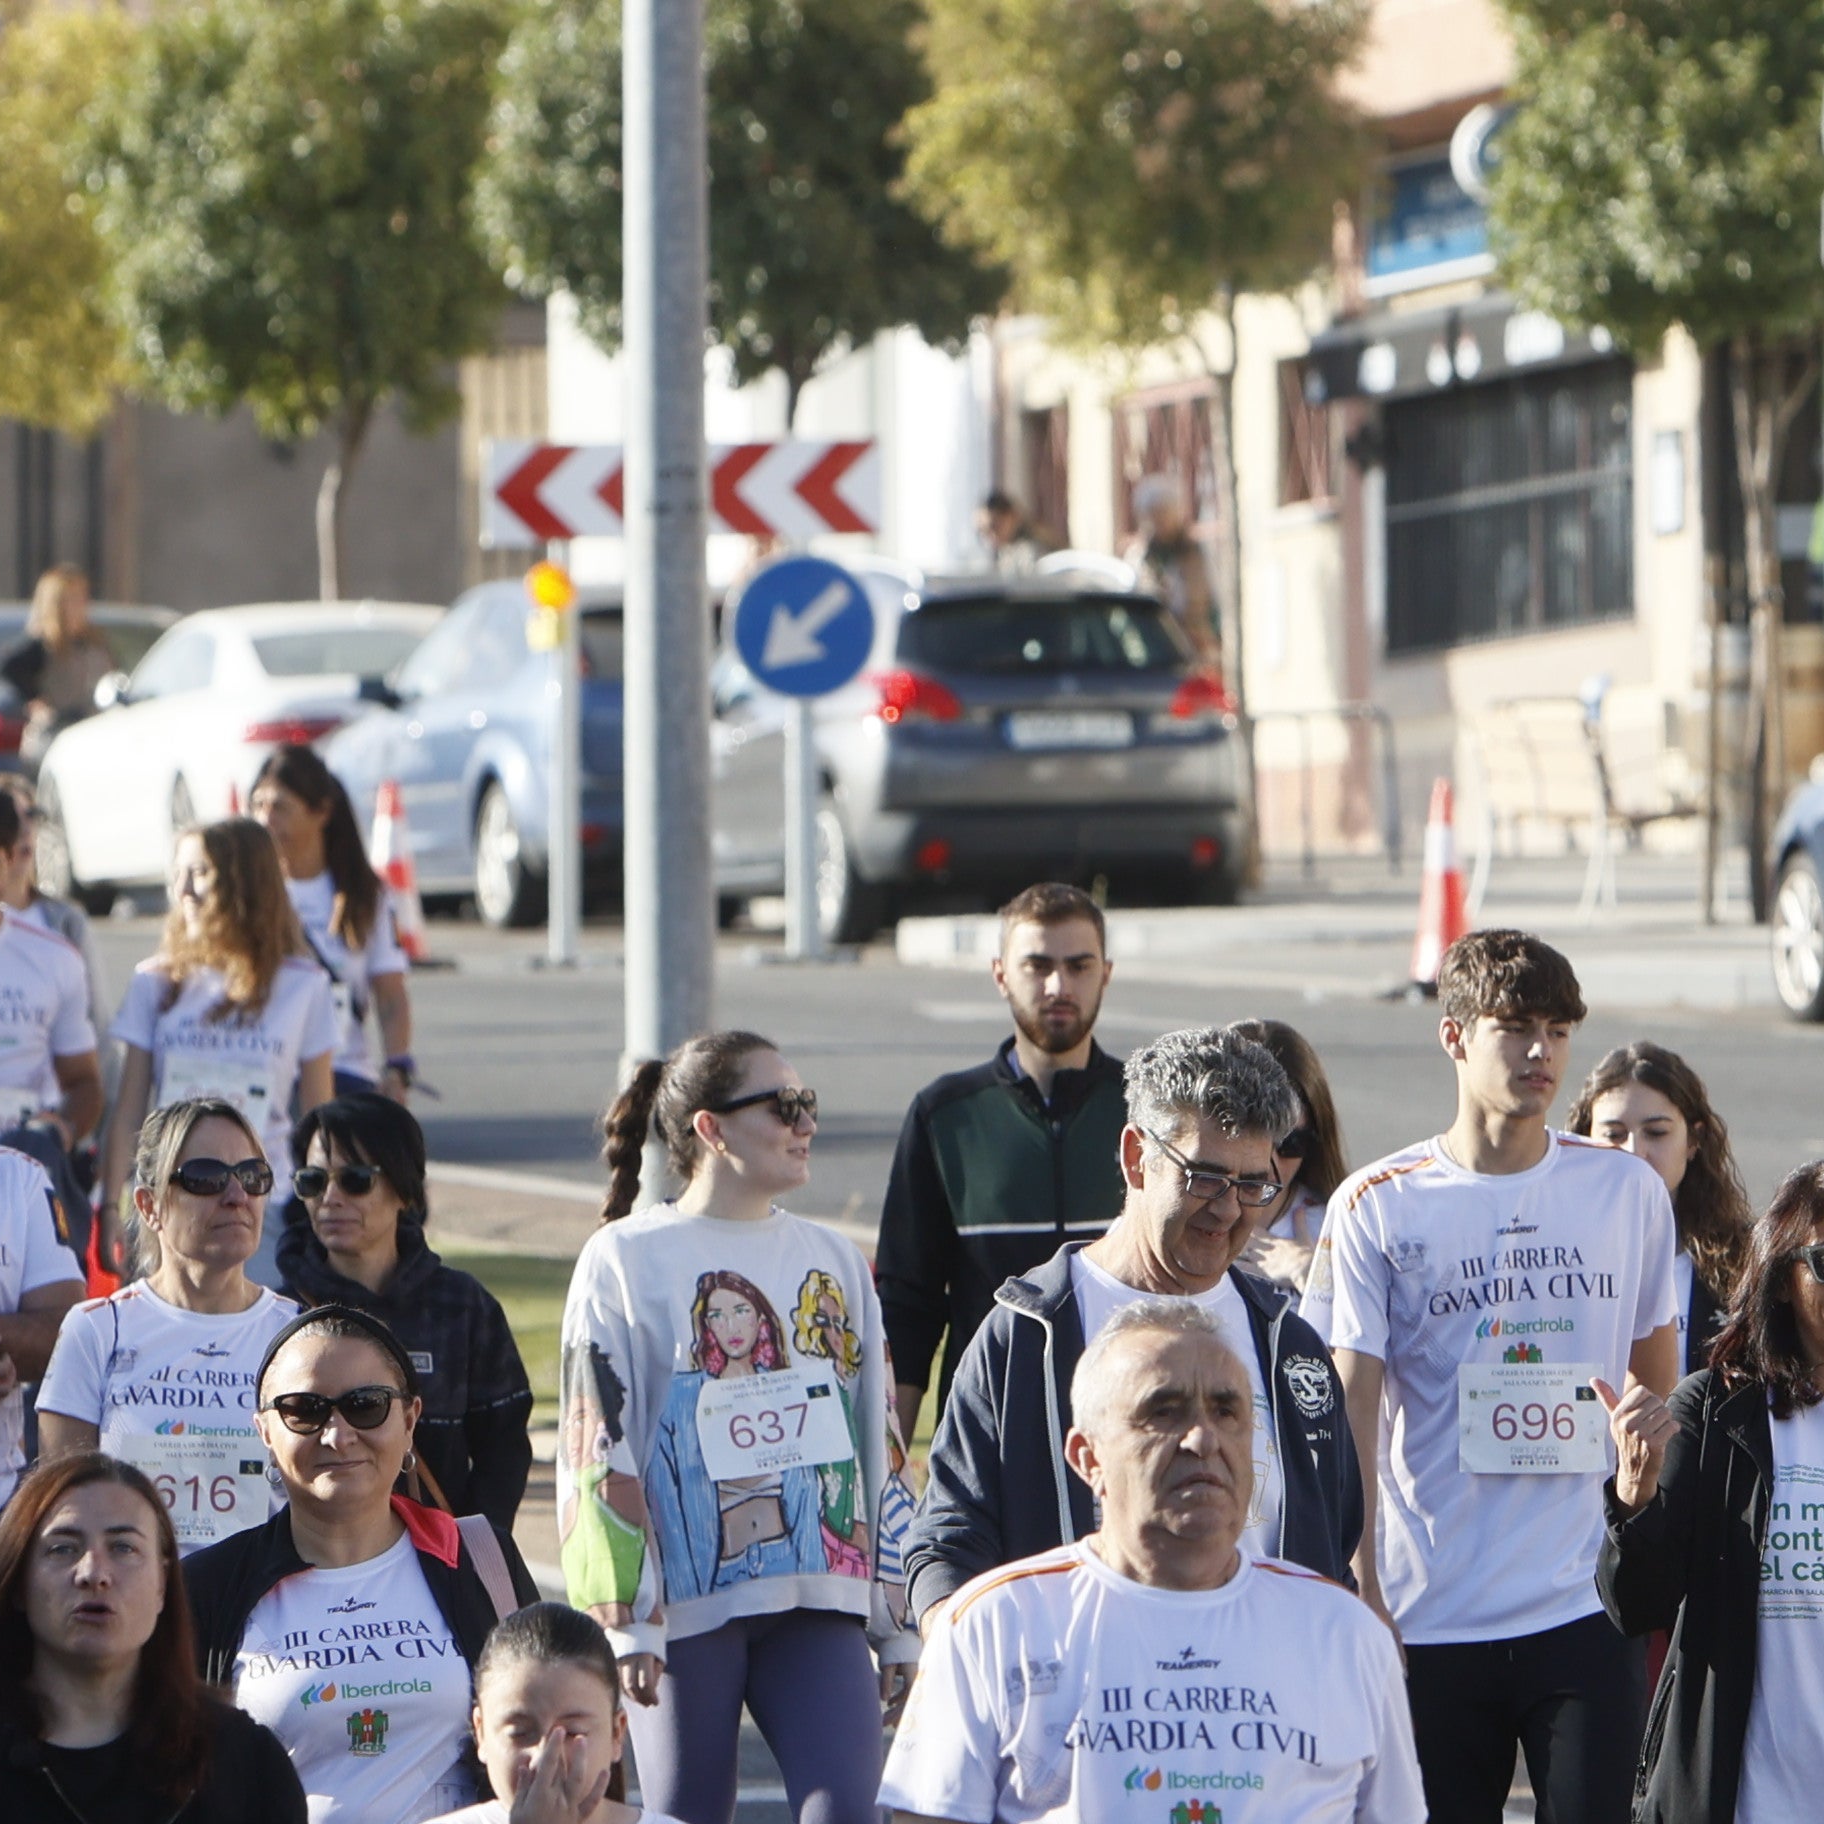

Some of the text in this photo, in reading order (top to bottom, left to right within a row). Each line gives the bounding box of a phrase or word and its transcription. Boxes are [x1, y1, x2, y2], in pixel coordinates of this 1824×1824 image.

[1460, 1245, 1584, 1281] III CARRERA
[1548, 1272, 1620, 1299] CIVIL
[1502, 1316, 1574, 1335] Iberdrola
[175, 1367, 256, 1388] CARRER
[729, 1402, 808, 1449] 637
[1492, 1402, 1576, 1442] 696
[153, 1474, 236, 1513] 616
[1770, 1501, 1791, 1521] n
[1759, 1555, 1784, 1582] el
[1794, 1588, 1804, 1596] EN
[284, 1619, 432, 1651] III CARRERA
[249, 1644, 384, 1680] GVARDIA
[1155, 1659, 1221, 1671] TEAMERGY
[341, 1678, 432, 1699] Iberdrola
[1101, 1686, 1279, 1716] III CARRERA
[1231, 1720, 1323, 1768] CIVIL
[1167, 1771, 1265, 1790] Iberdrola
